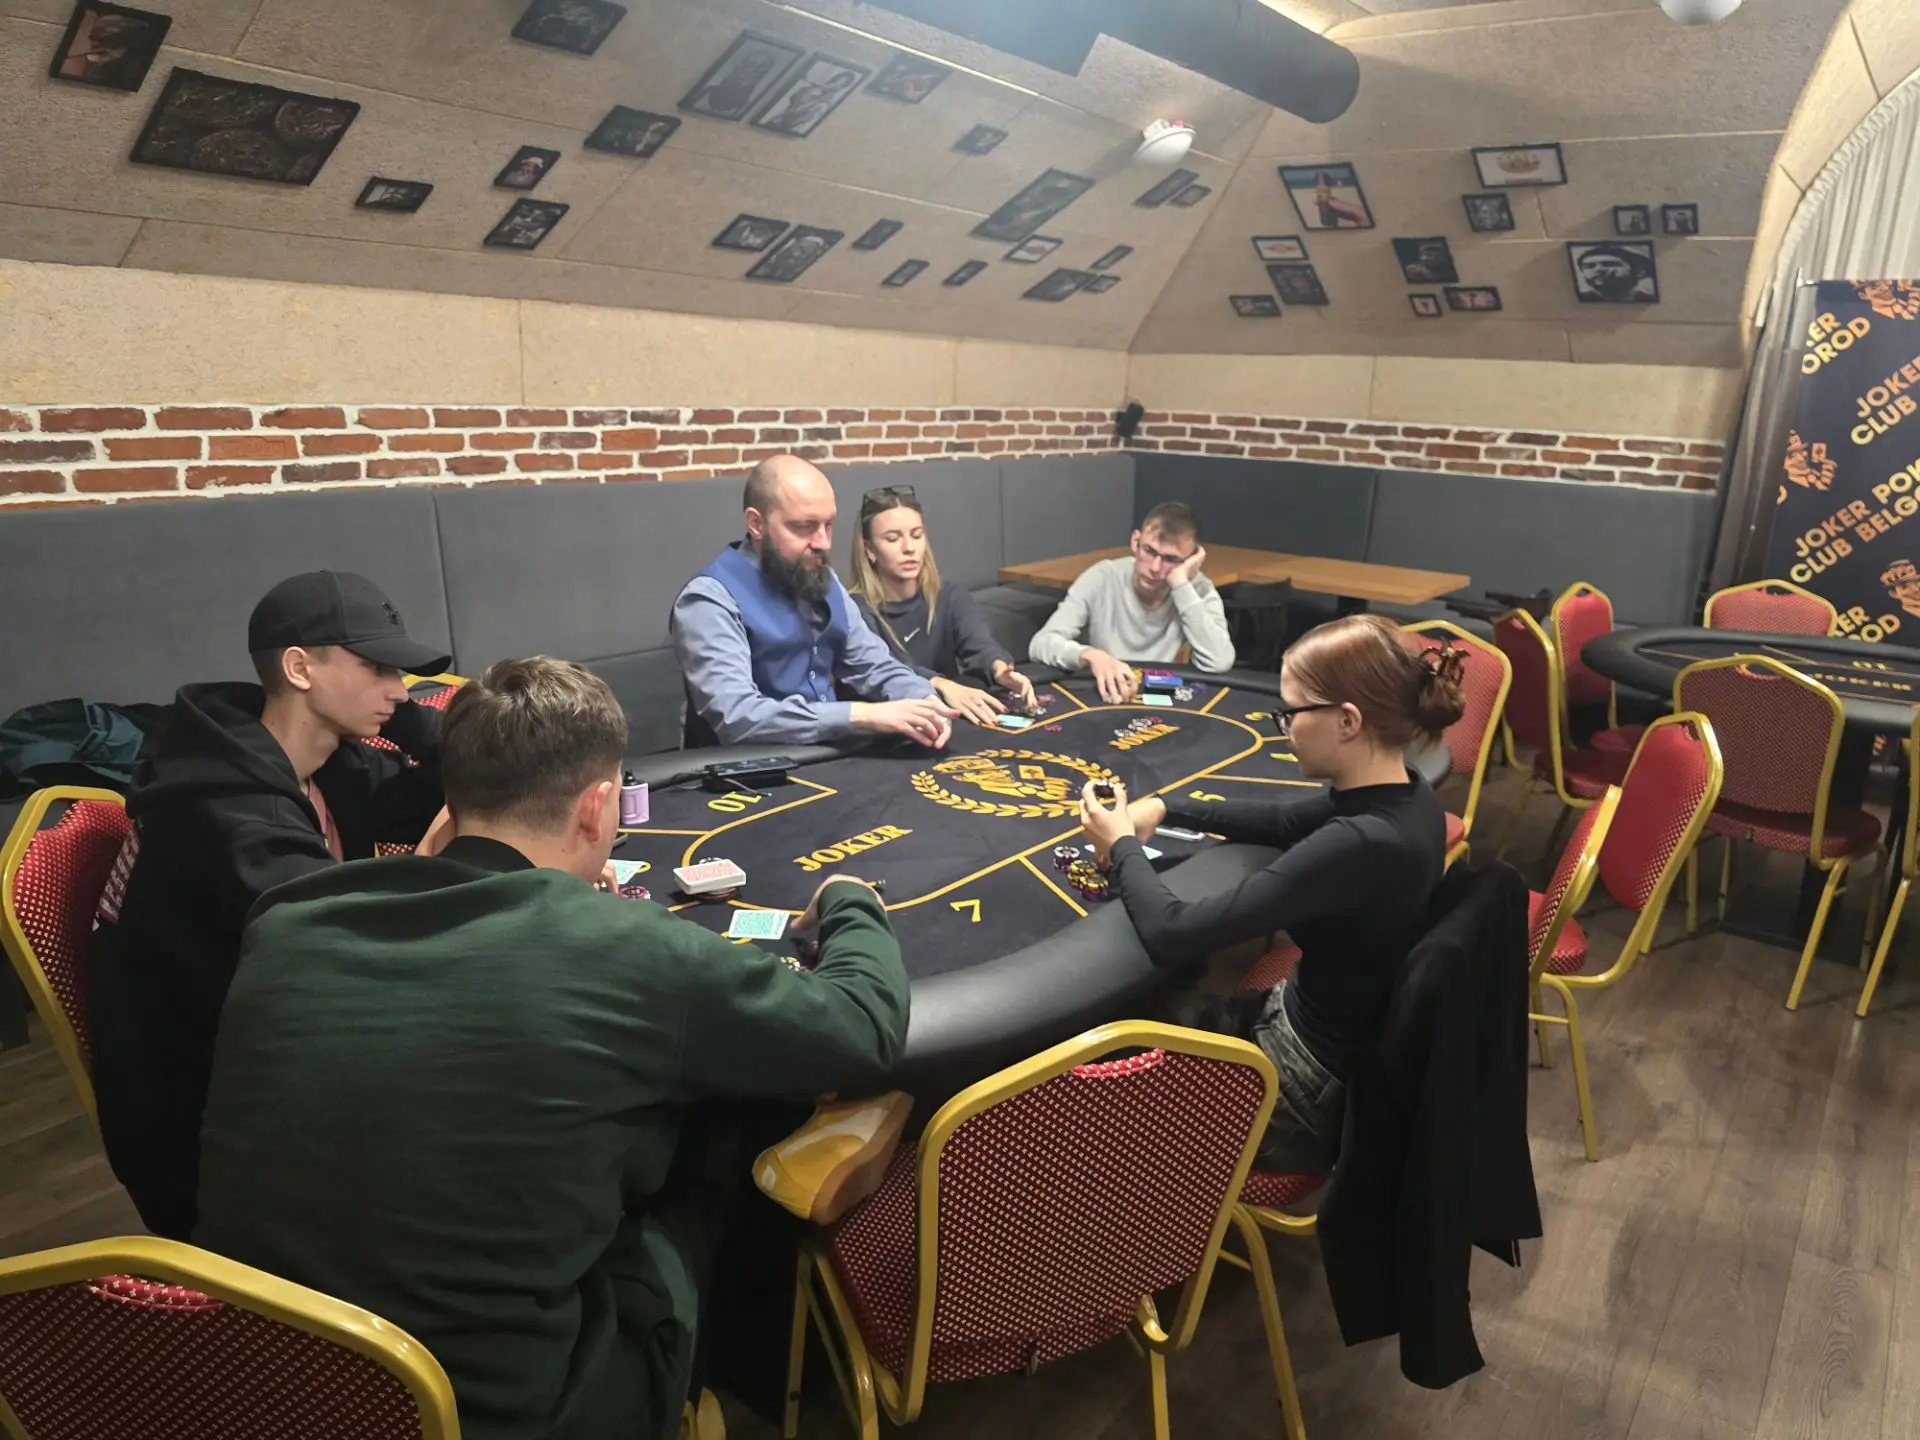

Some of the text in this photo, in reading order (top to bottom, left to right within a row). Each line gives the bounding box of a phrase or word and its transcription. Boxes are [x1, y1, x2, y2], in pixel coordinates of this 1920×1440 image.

[1801, 317, 1871, 375] OROD
[1850, 395, 1917, 445] CLUB
[1790, 484, 1920, 583] CLUB BELG
[1795, 500, 1871, 558] JOKER
[707, 791, 763, 813] 10
[792, 824, 914, 872] JOKER
[949, 898, 981, 923] 7
